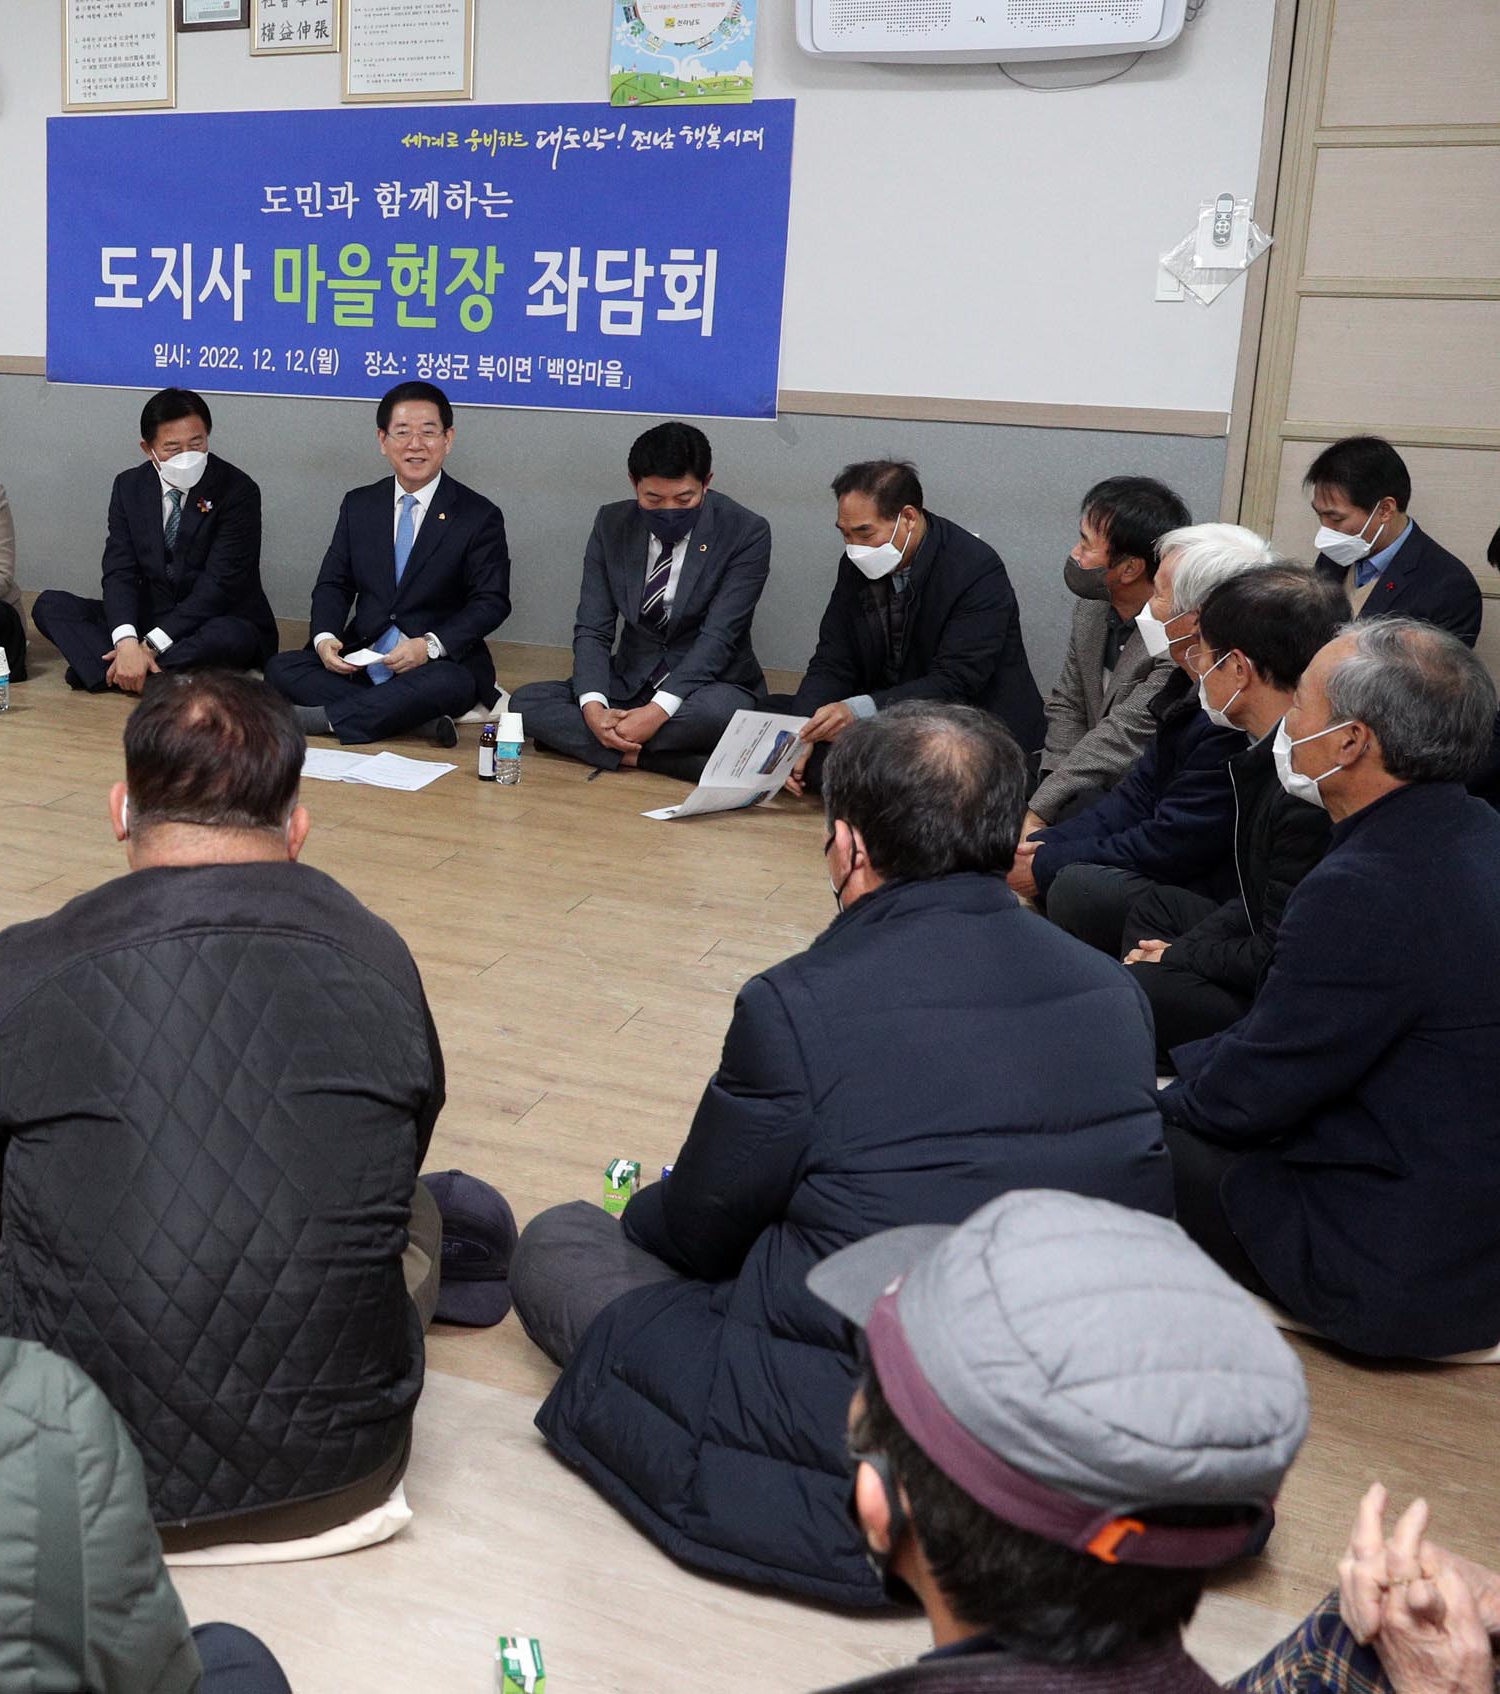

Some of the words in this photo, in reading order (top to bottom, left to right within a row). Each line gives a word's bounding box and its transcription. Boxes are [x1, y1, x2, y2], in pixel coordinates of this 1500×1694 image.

[260, 19, 330, 42] 權益伸張
[400, 131, 460, 149] 세계로
[463, 128, 530, 158] 웅비하는
[535, 123, 627, 171] 대도약!
[630, 127, 677, 152] 전남
[260, 181, 360, 220] 도민과
[373, 180, 514, 220] 함께하는
[94, 242, 252, 322] 도지사
[273, 242, 505, 333] 마을현장
[525, 246, 718, 337] 좌담회
[153, 342, 191, 369] 일시:
[198, 345, 244, 371] 2022.
[252, 348, 276, 372] 12.
[285, 347, 340, 376] 12.(월)
[364, 350, 407, 377] 장소:
[415, 352, 471, 381] 장성군
[476, 354, 532, 384] 북이면
